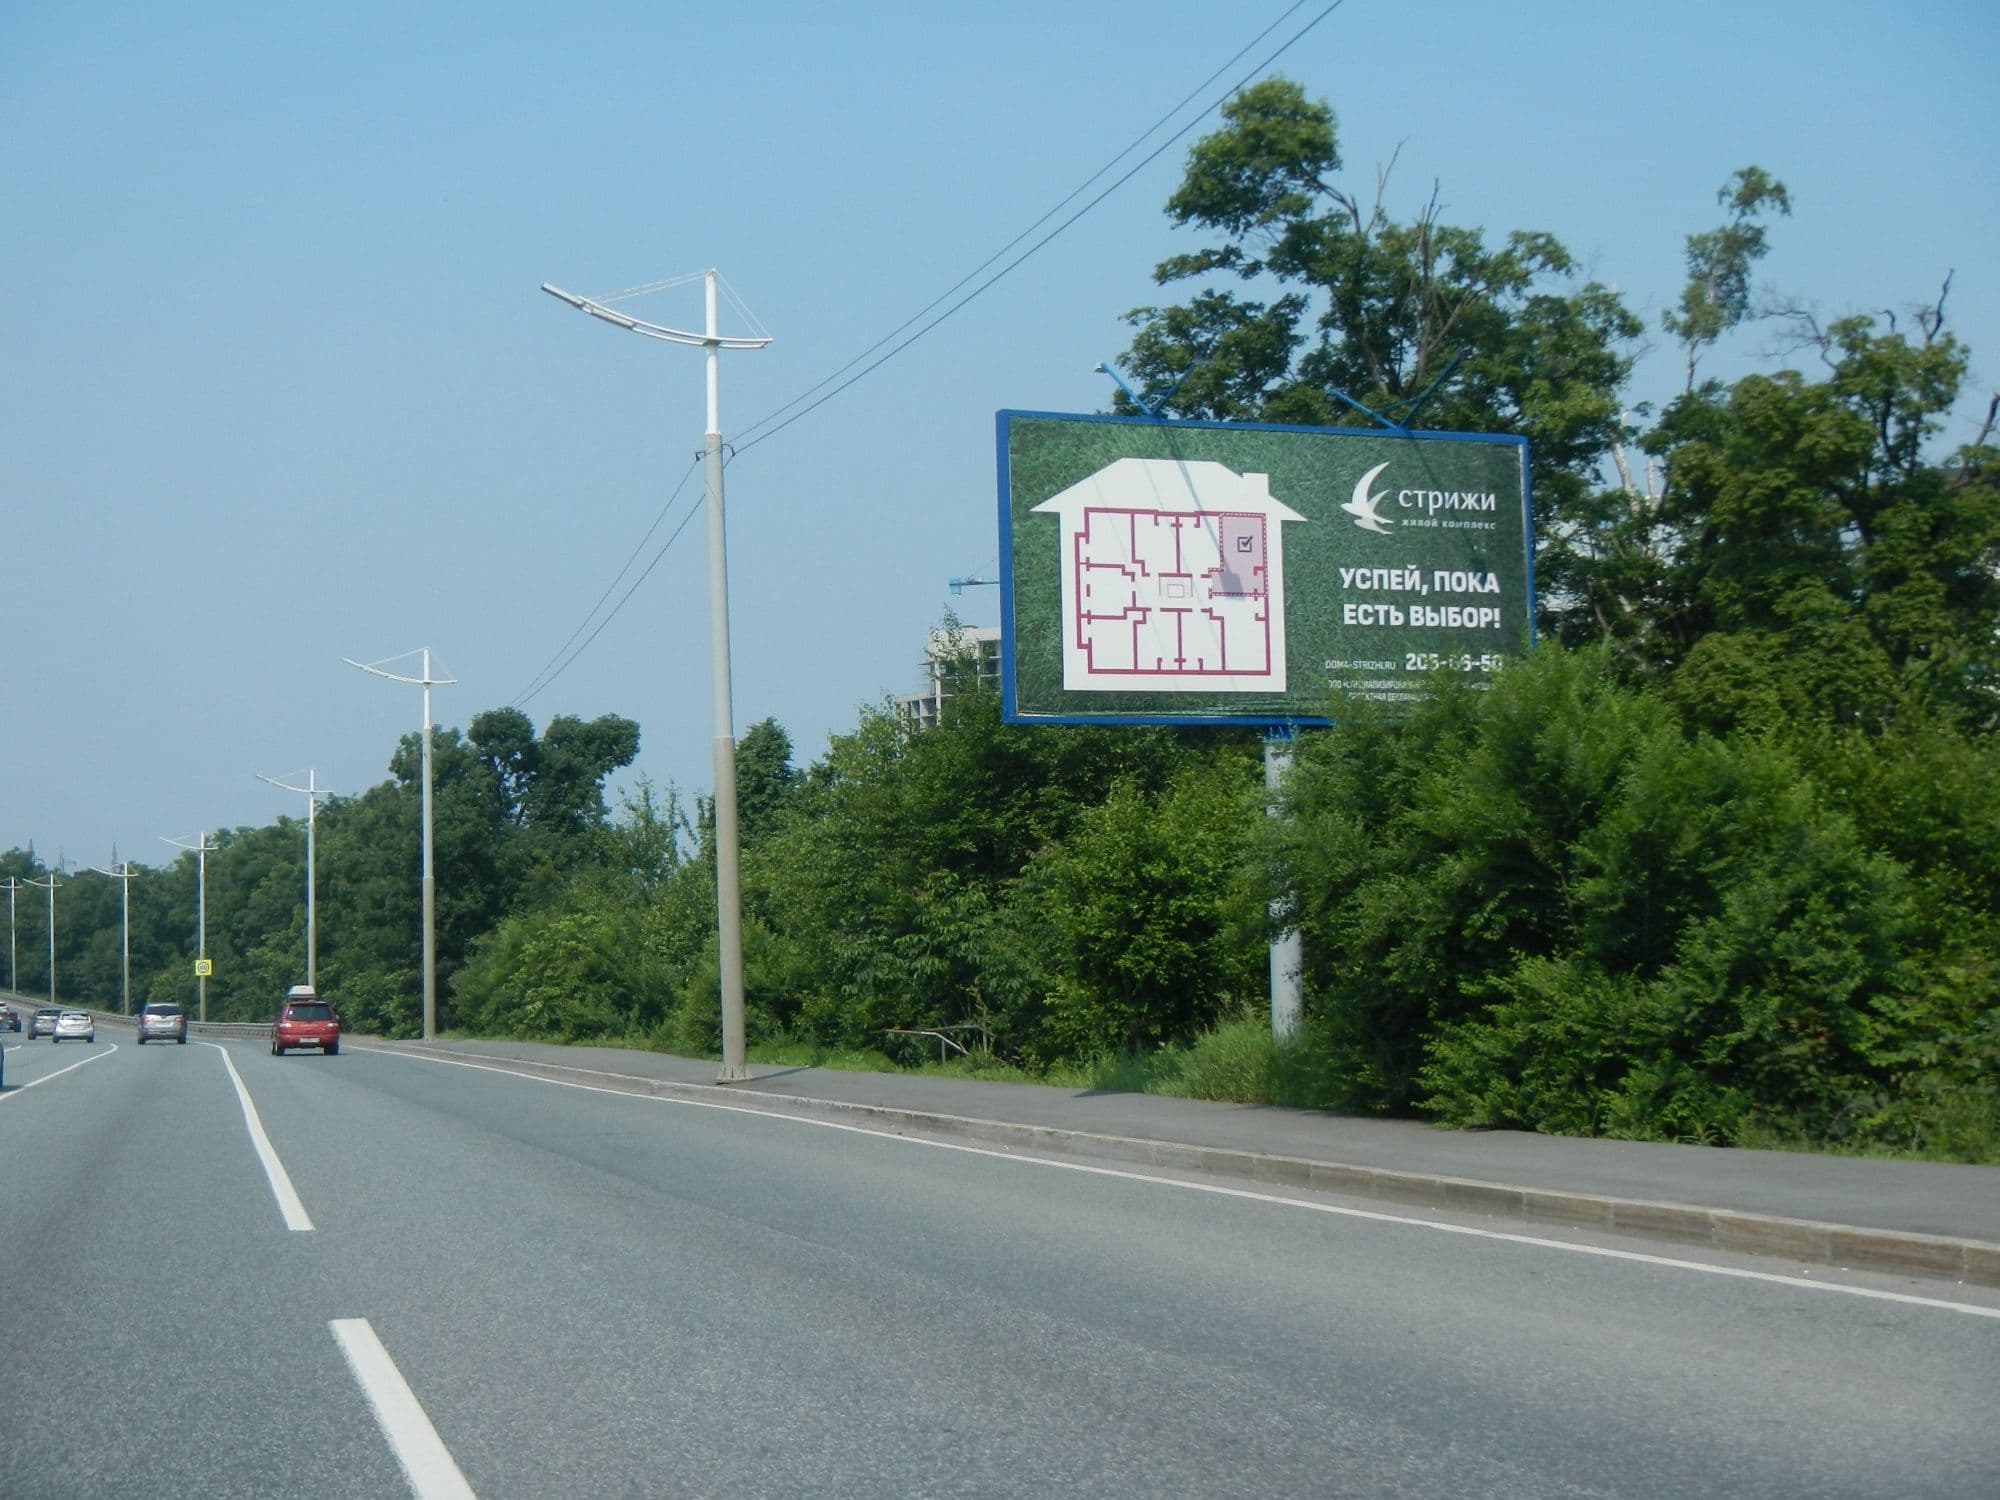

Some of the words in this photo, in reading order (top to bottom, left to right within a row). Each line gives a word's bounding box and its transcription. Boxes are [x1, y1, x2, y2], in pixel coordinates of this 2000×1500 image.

[1398, 489, 1496, 515] стрижи
[1401, 519, 1438, 527] жилой
[1442, 520, 1496, 529] комплекс
[1340, 564, 1428, 595] УСПЕЙ,
[1434, 570, 1500, 594] ПОКА
[1343, 603, 1404, 626] ЕСТЬ
[1409, 605, 1501, 629] ВЫБОР!
